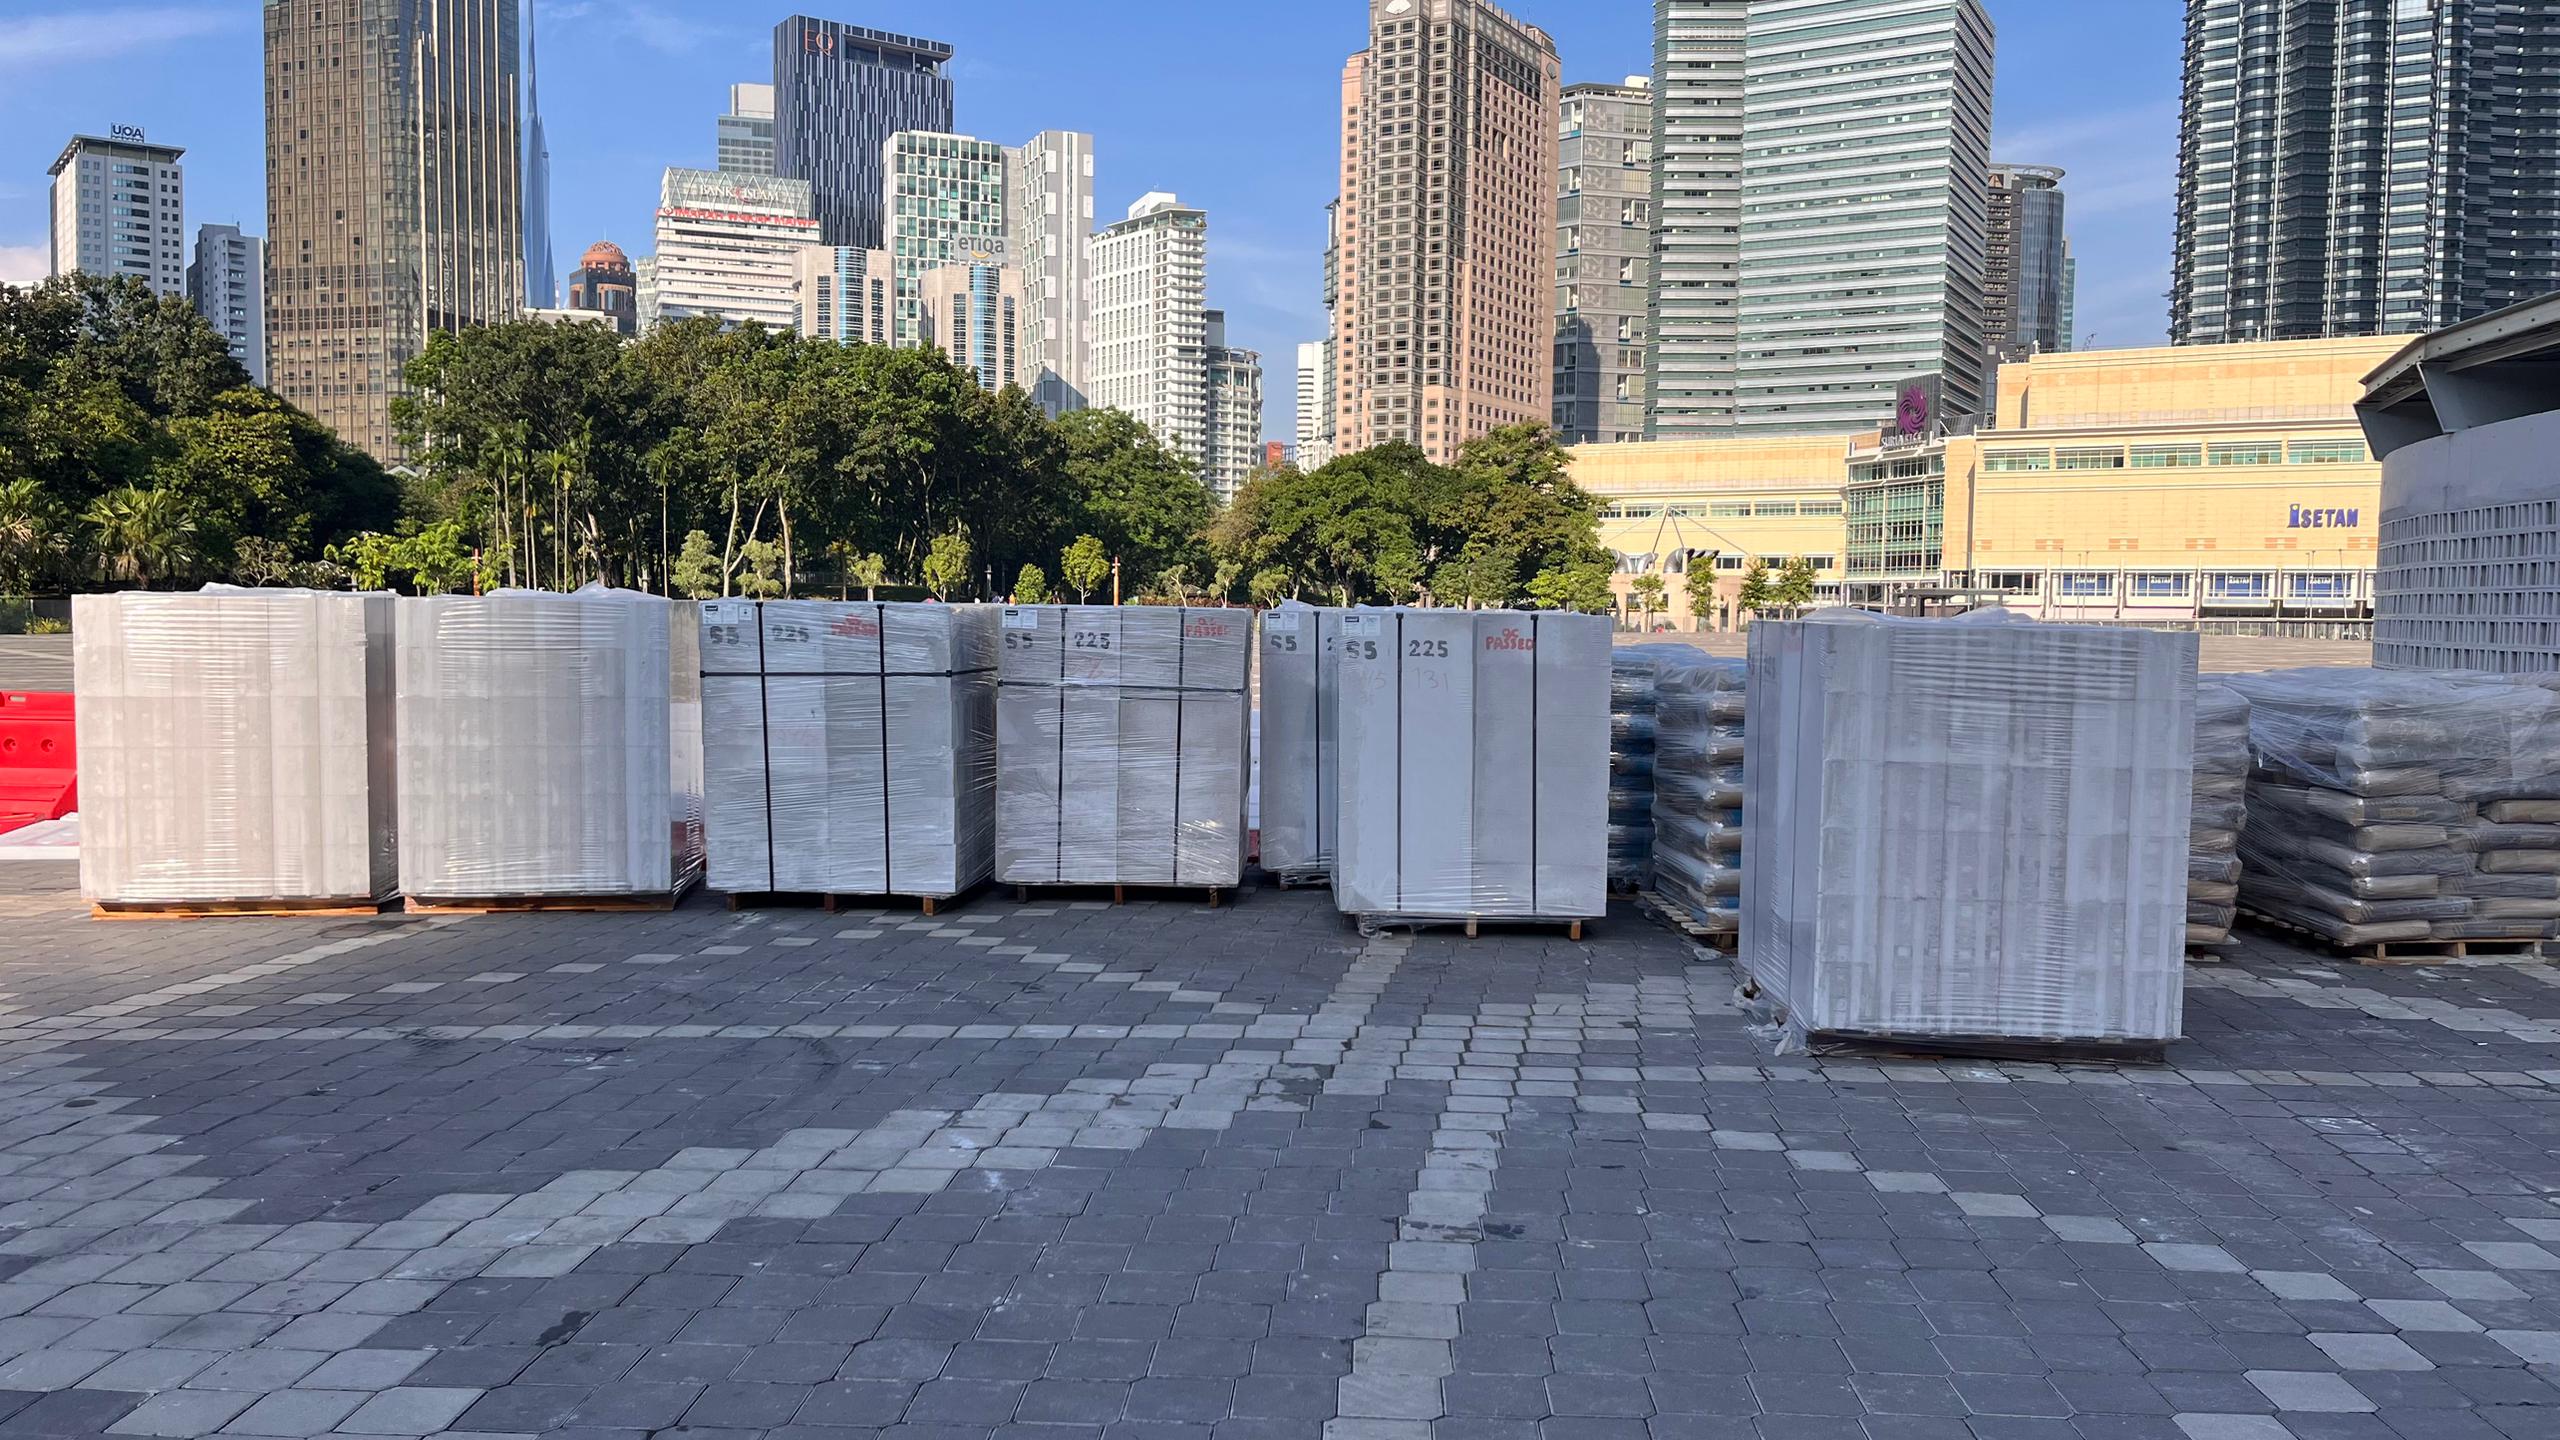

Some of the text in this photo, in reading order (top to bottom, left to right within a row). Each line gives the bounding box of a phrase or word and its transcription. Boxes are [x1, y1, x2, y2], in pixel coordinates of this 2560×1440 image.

[804, 29, 833, 57] EQ
[112, 124, 144, 138] UOA
[700, 184, 780, 201] BANK ISLAM
[772, 624, 810, 643] 225
[1074, 632, 1112, 650] 225
[1409, 640, 1448, 658] 225
[1485, 636, 1535, 651] PASSED
